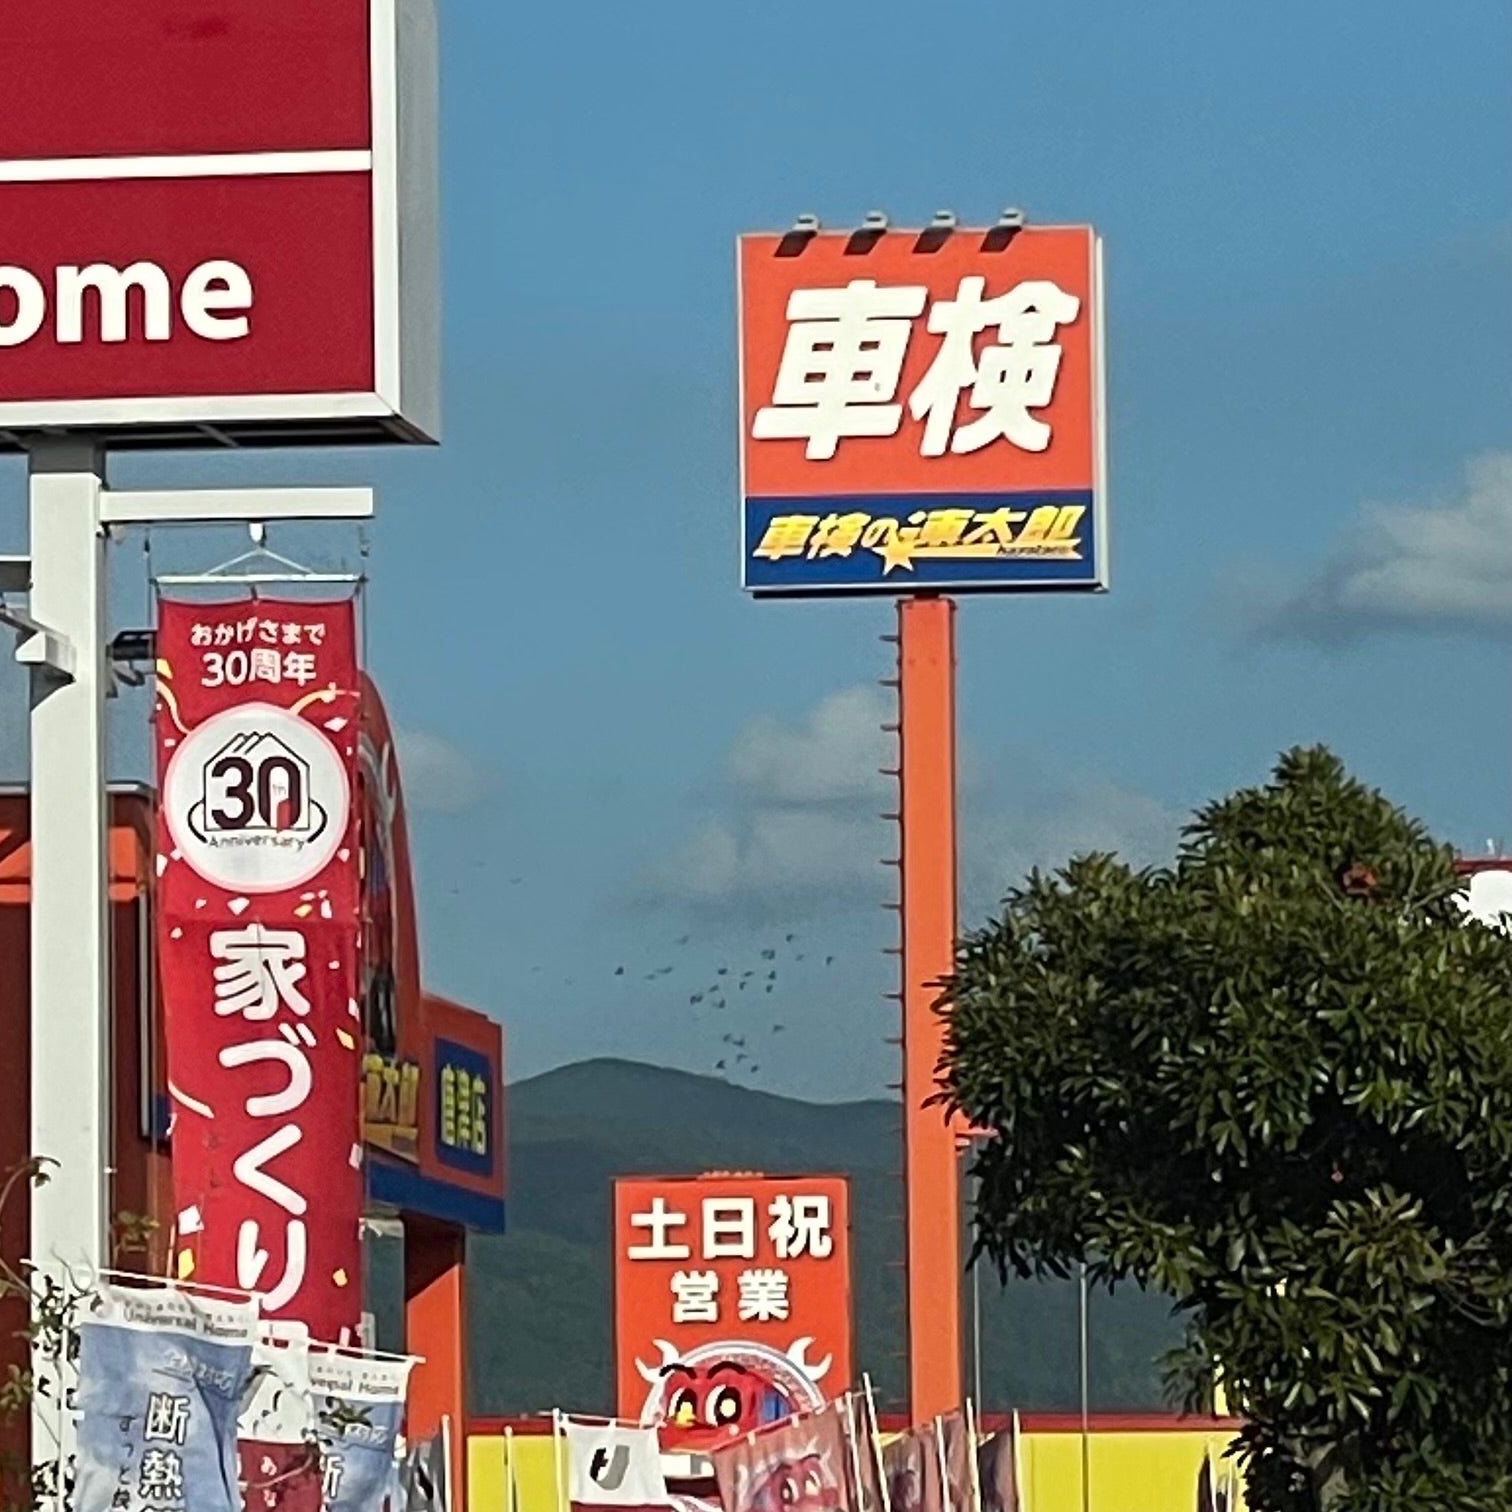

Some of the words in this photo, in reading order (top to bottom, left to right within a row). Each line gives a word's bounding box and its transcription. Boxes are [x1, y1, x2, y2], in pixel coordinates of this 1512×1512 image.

[751, 275, 1081, 460] 車検
[191, 617, 326, 646] おかげさまで
[201, 648, 317, 687] 30周年
[211, 756, 301, 830] 30
[627, 1195, 833, 1261] 土日祝
[670, 1269, 790, 1323] 営業
[138, 1392, 191, 1512] 断熱
